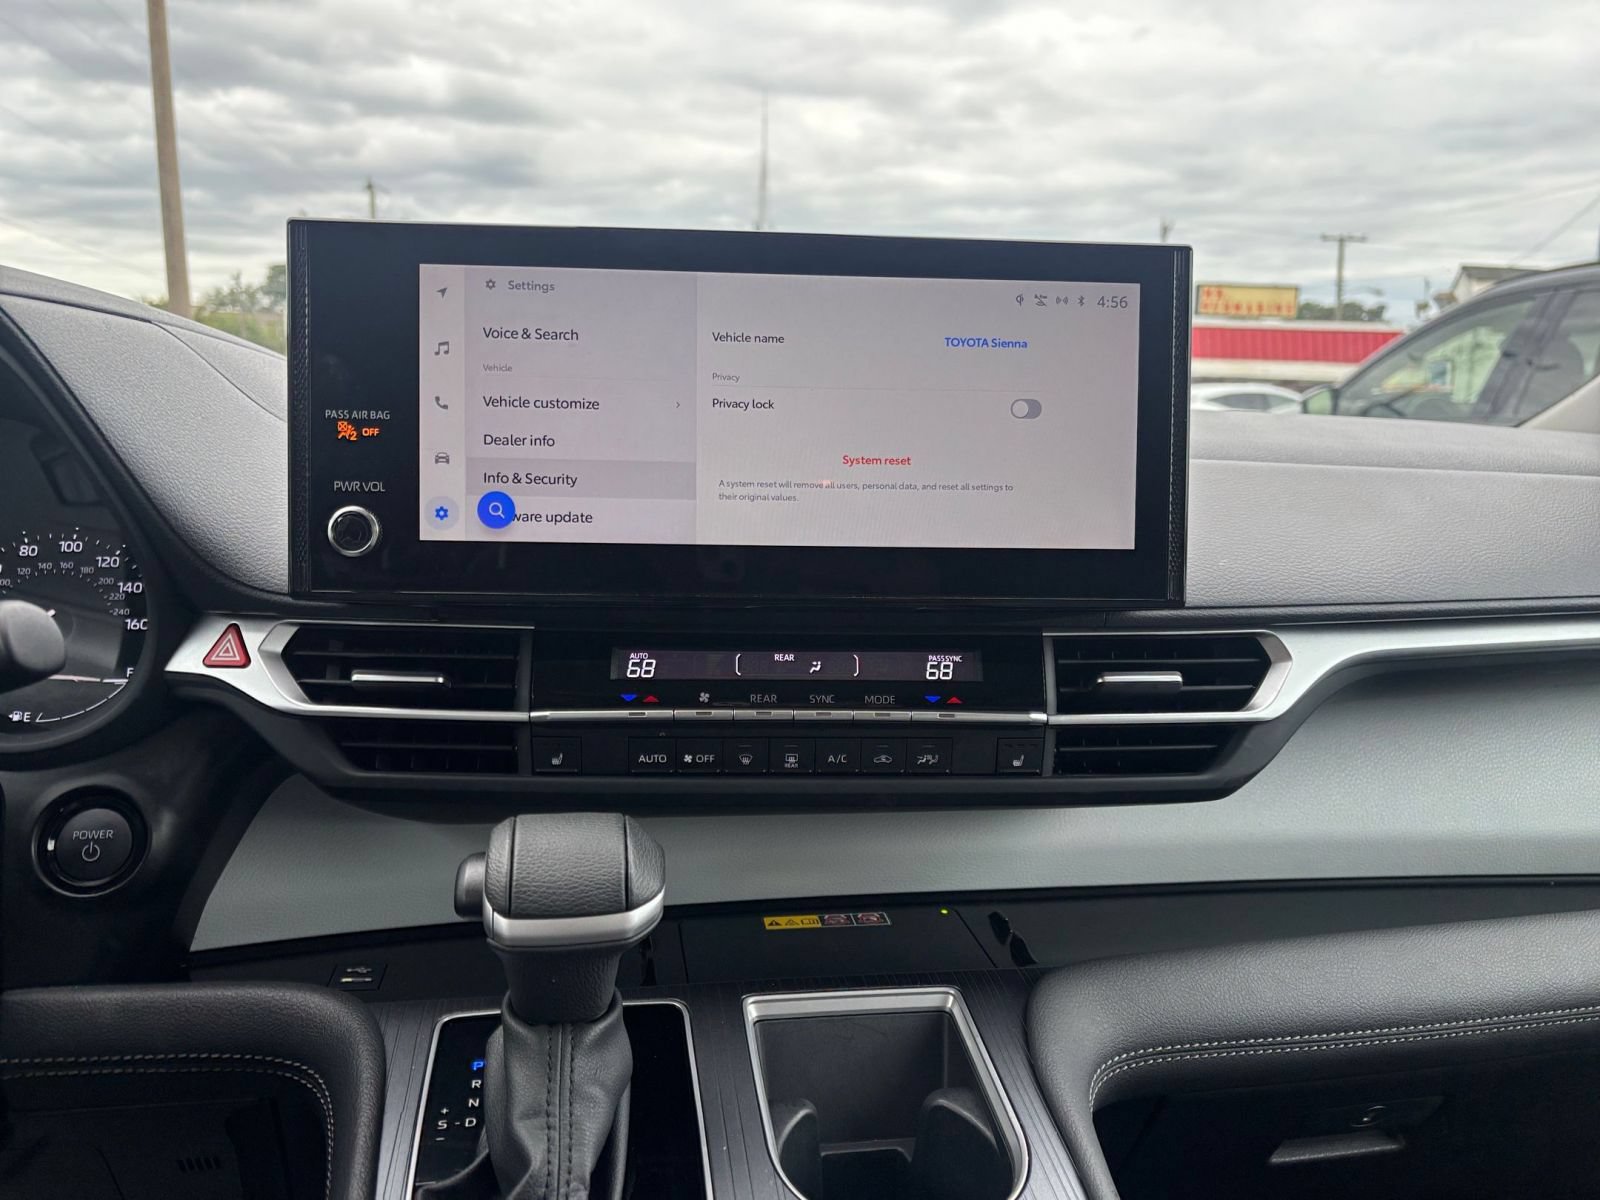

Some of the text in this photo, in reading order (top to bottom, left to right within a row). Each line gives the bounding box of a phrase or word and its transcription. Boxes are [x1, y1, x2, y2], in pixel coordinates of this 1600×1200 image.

[508, 280, 555, 293] Settings
[1097, 296, 1128, 309] 4:56
[483, 327, 579, 341] Voice & Search
[712, 332, 785, 344] Vehicle name
[944, 337, 1028, 349] TOYOTA Sienna
[483, 363, 513, 373] Vehicle
[712, 372, 741, 384] Privacy
[483, 395, 600, 410] Vehicle customize
[712, 398, 775, 412] Privacy lock
[325, 409, 391, 421] PASS AIR BAG
[362, 427, 380, 437] OFF
[483, 433, 556, 447] Dealer info
[842, 454, 912, 468] System reset
[483, 471, 578, 487] Info & Security
[334, 480, 386, 492] PWR VOL
[718, 480, 726, 488] A
[726, 481, 755, 490] system
[757, 480, 778, 488] reset
[778, 480, 792, 488] will
[794, 481, 824, 489] remove
[837, 481, 860, 491] users,
[862, 481, 897, 491] personal
[899, 481, 920, 492] data,
[921, 482, 937, 490] and
[938, 482, 959, 491] reset
[960, 482, 970, 491] all
[971, 482, 1004, 493] settings
[1005, 483, 1014, 491] to
[718, 492, 738, 501] their
[738, 492, 770, 503] original
[546, 511, 593, 525] update
[19, 545, 38, 557] 80
[59, 540, 83, 552] 100
[38, 562, 53, 570] 140
[60, 561, 74, 569] 160
[96, 556, 120, 568] 120
[17, 567, 31, 575] 120
[80, 566, 95, 574] 180
[98, 576, 115, 585] 200
[117, 582, 143, 594] 140
[109, 592, 126, 600] 220
[112, 607, 130, 616] 240
[629, 652, 649, 660] AUTO
[774, 653, 796, 662] REAR
[928, 654, 945, 662] PASS
[126, 667, 135, 678] F
[626, 659, 657, 678] 68
[925, 662, 954, 680] 68
[750, 693, 778, 704] REAR
[809, 695, 836, 704] SYNC
[864, 695, 896, 705] MODE
[23, 711, 31, 722] E
[638, 754, 667, 764] AUTO
[695, 754, 715, 763] OFF
[827, 754, 847, 764] A/C
[72, 829, 114, 841] POWER
[472, 1061, 484, 1071] P
[471, 1079, 482, 1089] R
[468, 1098, 480, 1108] N
[437, 1117, 477, 1130] S D
